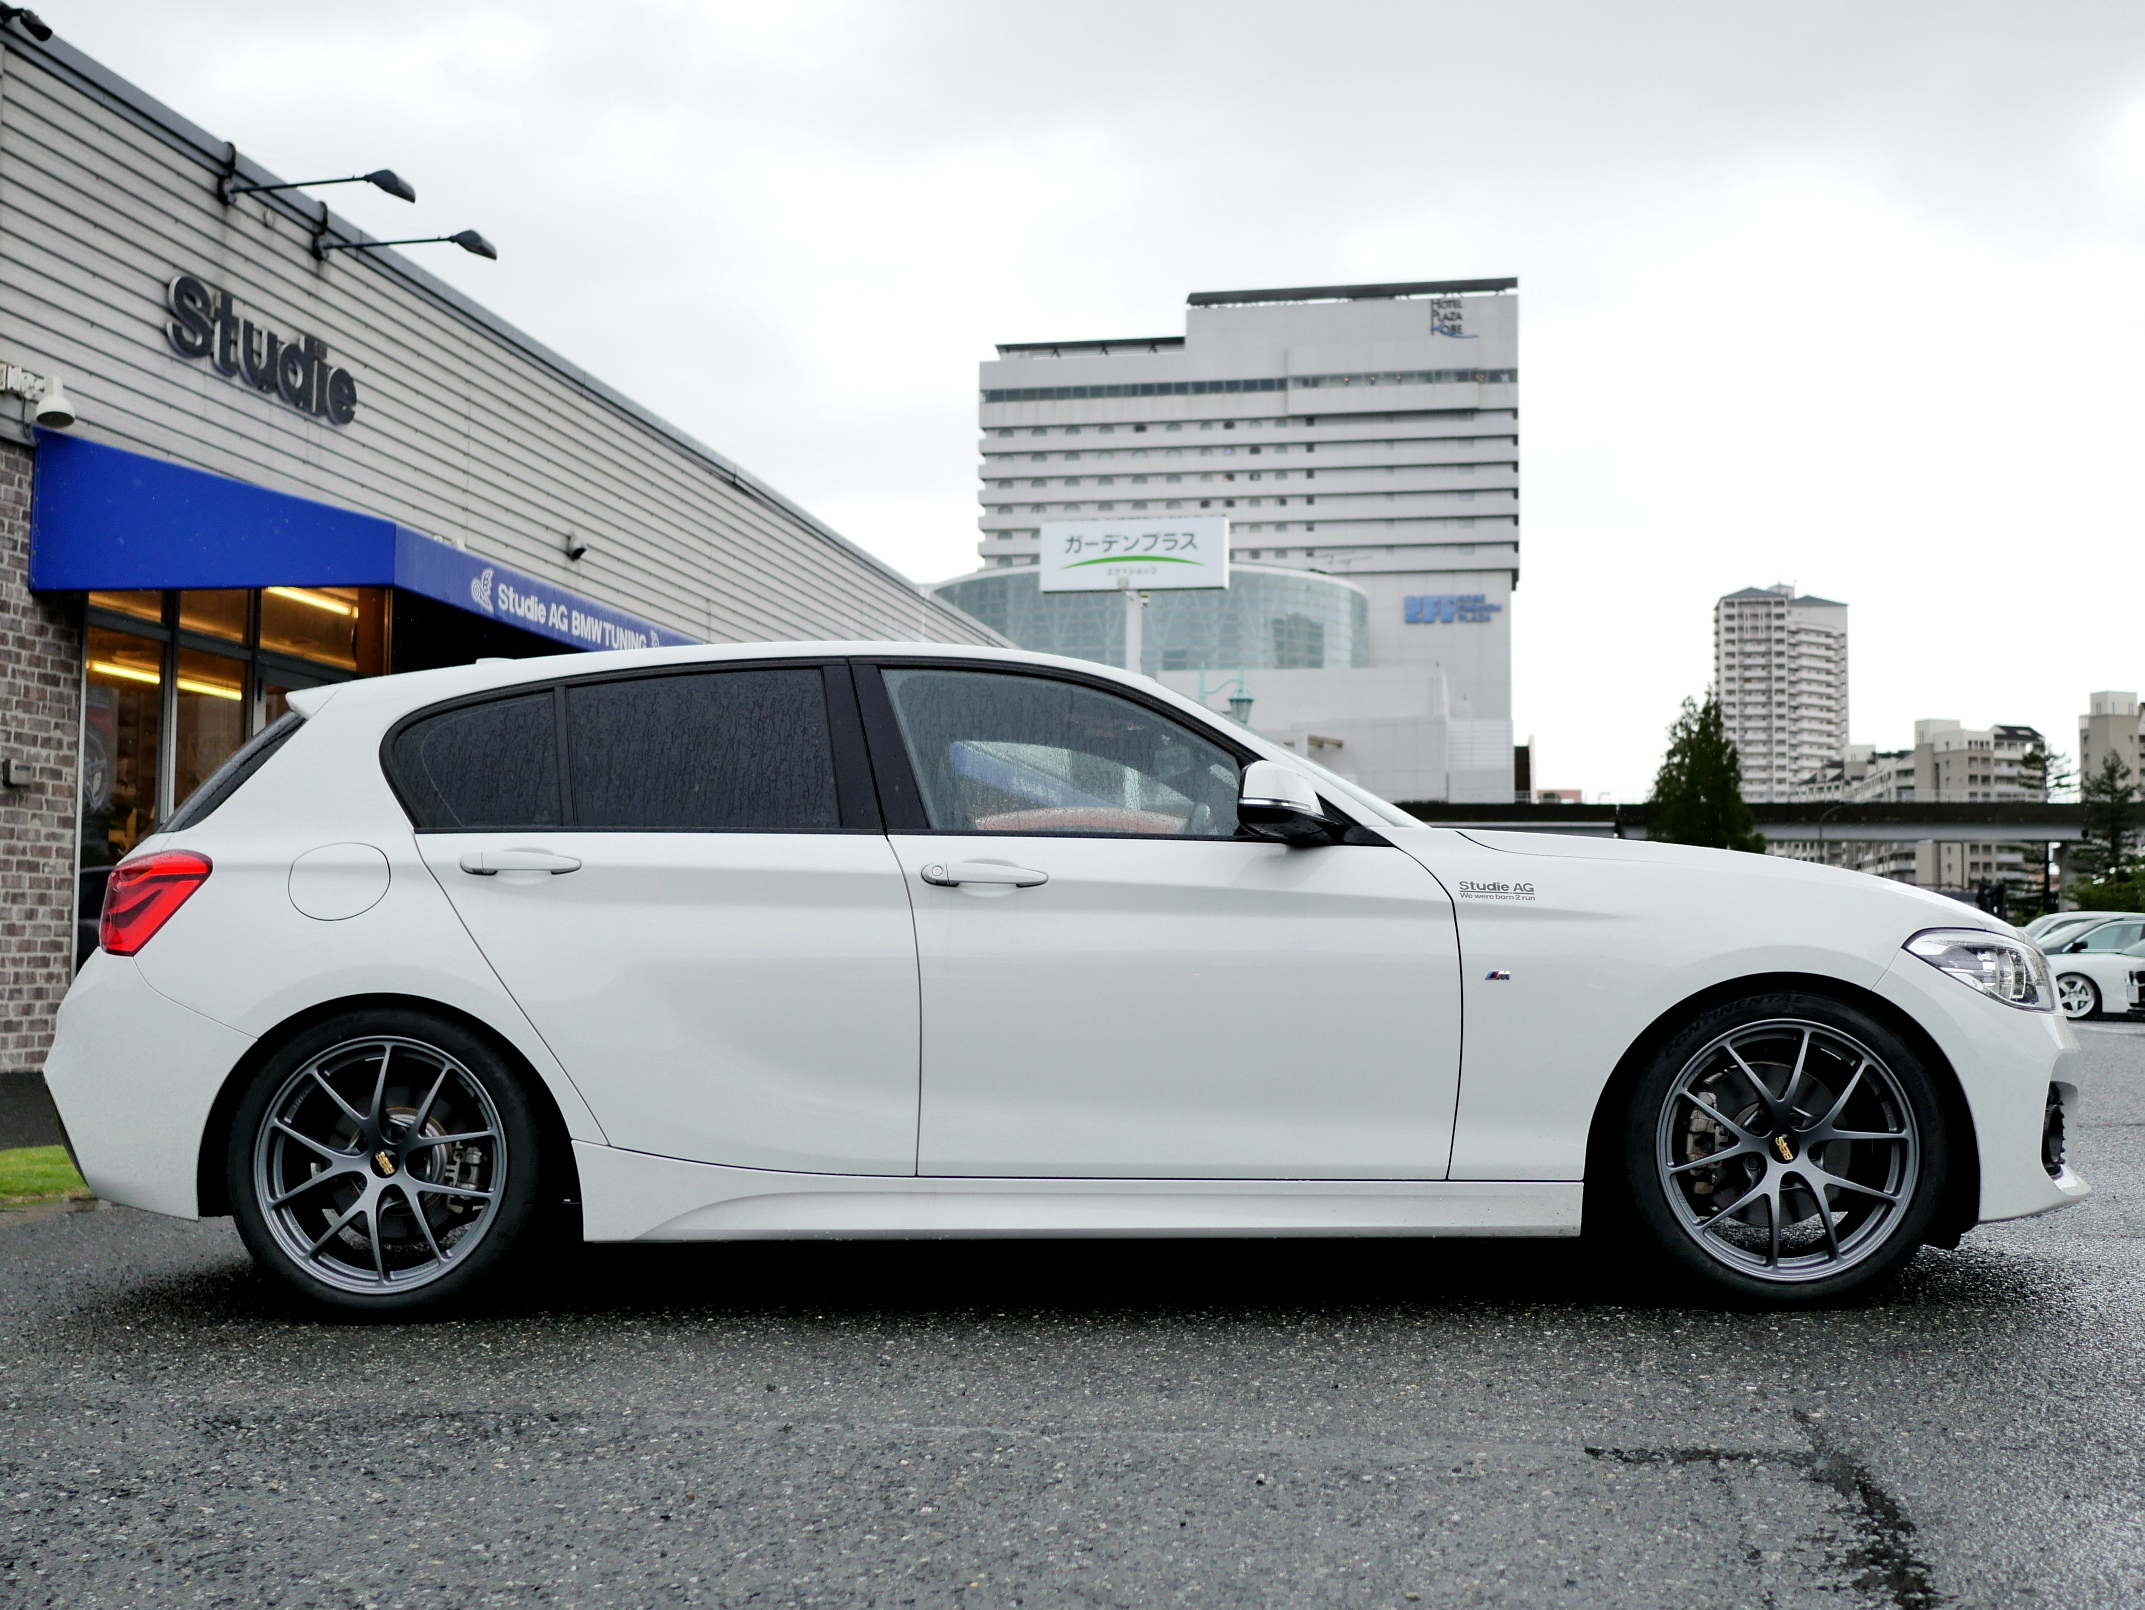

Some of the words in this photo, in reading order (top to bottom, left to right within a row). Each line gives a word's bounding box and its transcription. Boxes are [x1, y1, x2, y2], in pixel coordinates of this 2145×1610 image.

[166, 275, 358, 426] Studie
[1065, 532, 1199, 553] ガーデンプラス
[498, 583, 546, 624] Studie
[548, 603, 569, 632] AG
[571, 610, 601, 644] BMW
[603, 621, 647, 650] TUNING
[1459, 881, 1510, 892] Studie
[1513, 883, 1535, 893] AG
